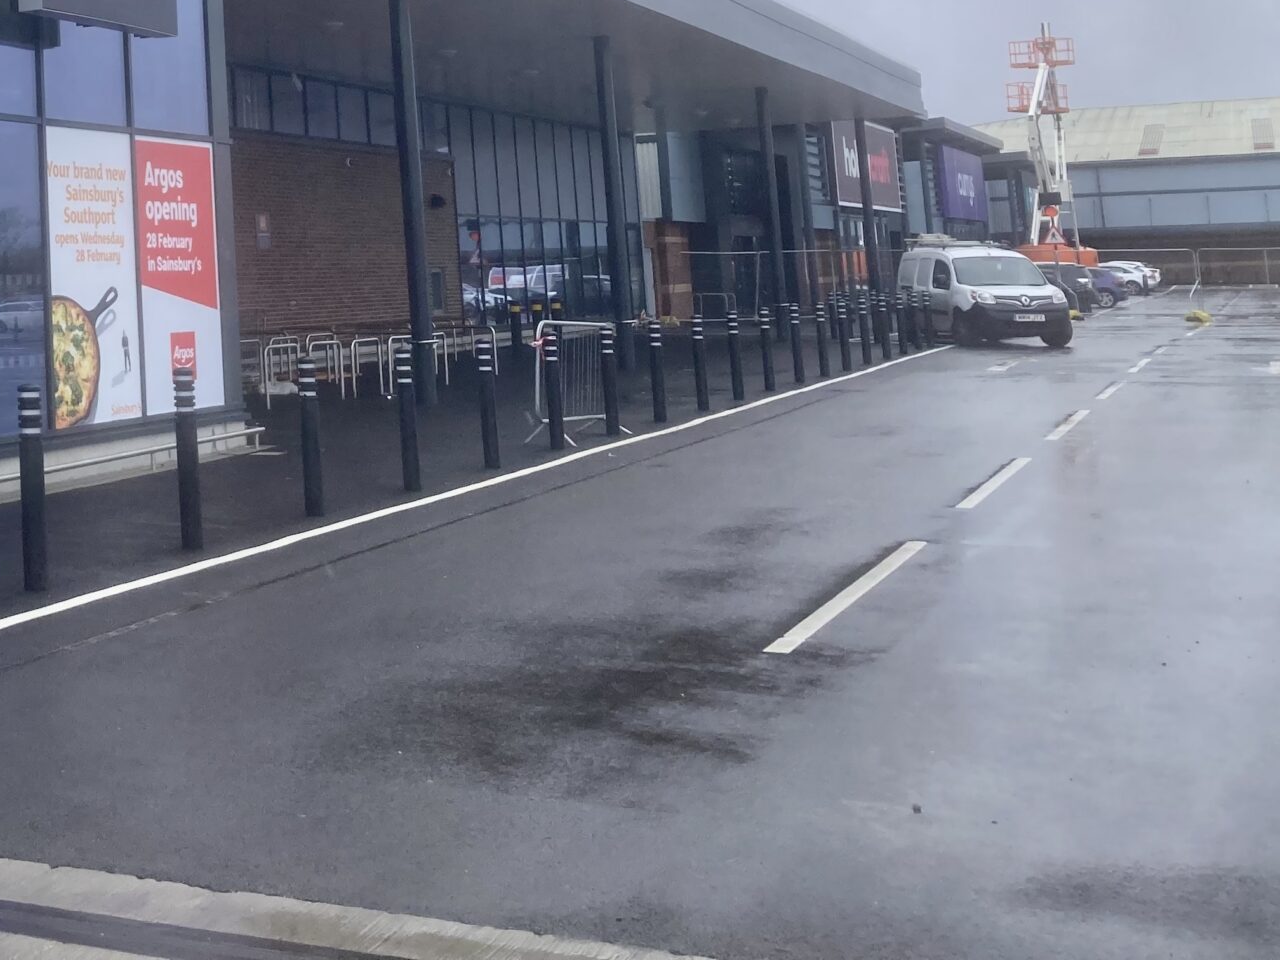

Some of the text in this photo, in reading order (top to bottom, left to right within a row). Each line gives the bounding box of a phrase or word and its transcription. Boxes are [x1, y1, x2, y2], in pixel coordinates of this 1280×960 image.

[73, 161, 103, 180] brand
[106, 168, 126, 181] new
[145, 161, 183, 193] Argos
[65, 184, 124, 207] Sainsbury's
[64, 206, 116, 228] Southport
[145, 196, 197, 227] opening
[55, 232, 124, 247] opens Wednesday
[146, 233, 192, 252] 28 February
[76, 249, 120, 264] 28 February
[148, 255, 201, 275] in Sainsbury's
[172, 344, 194, 362] Argos
